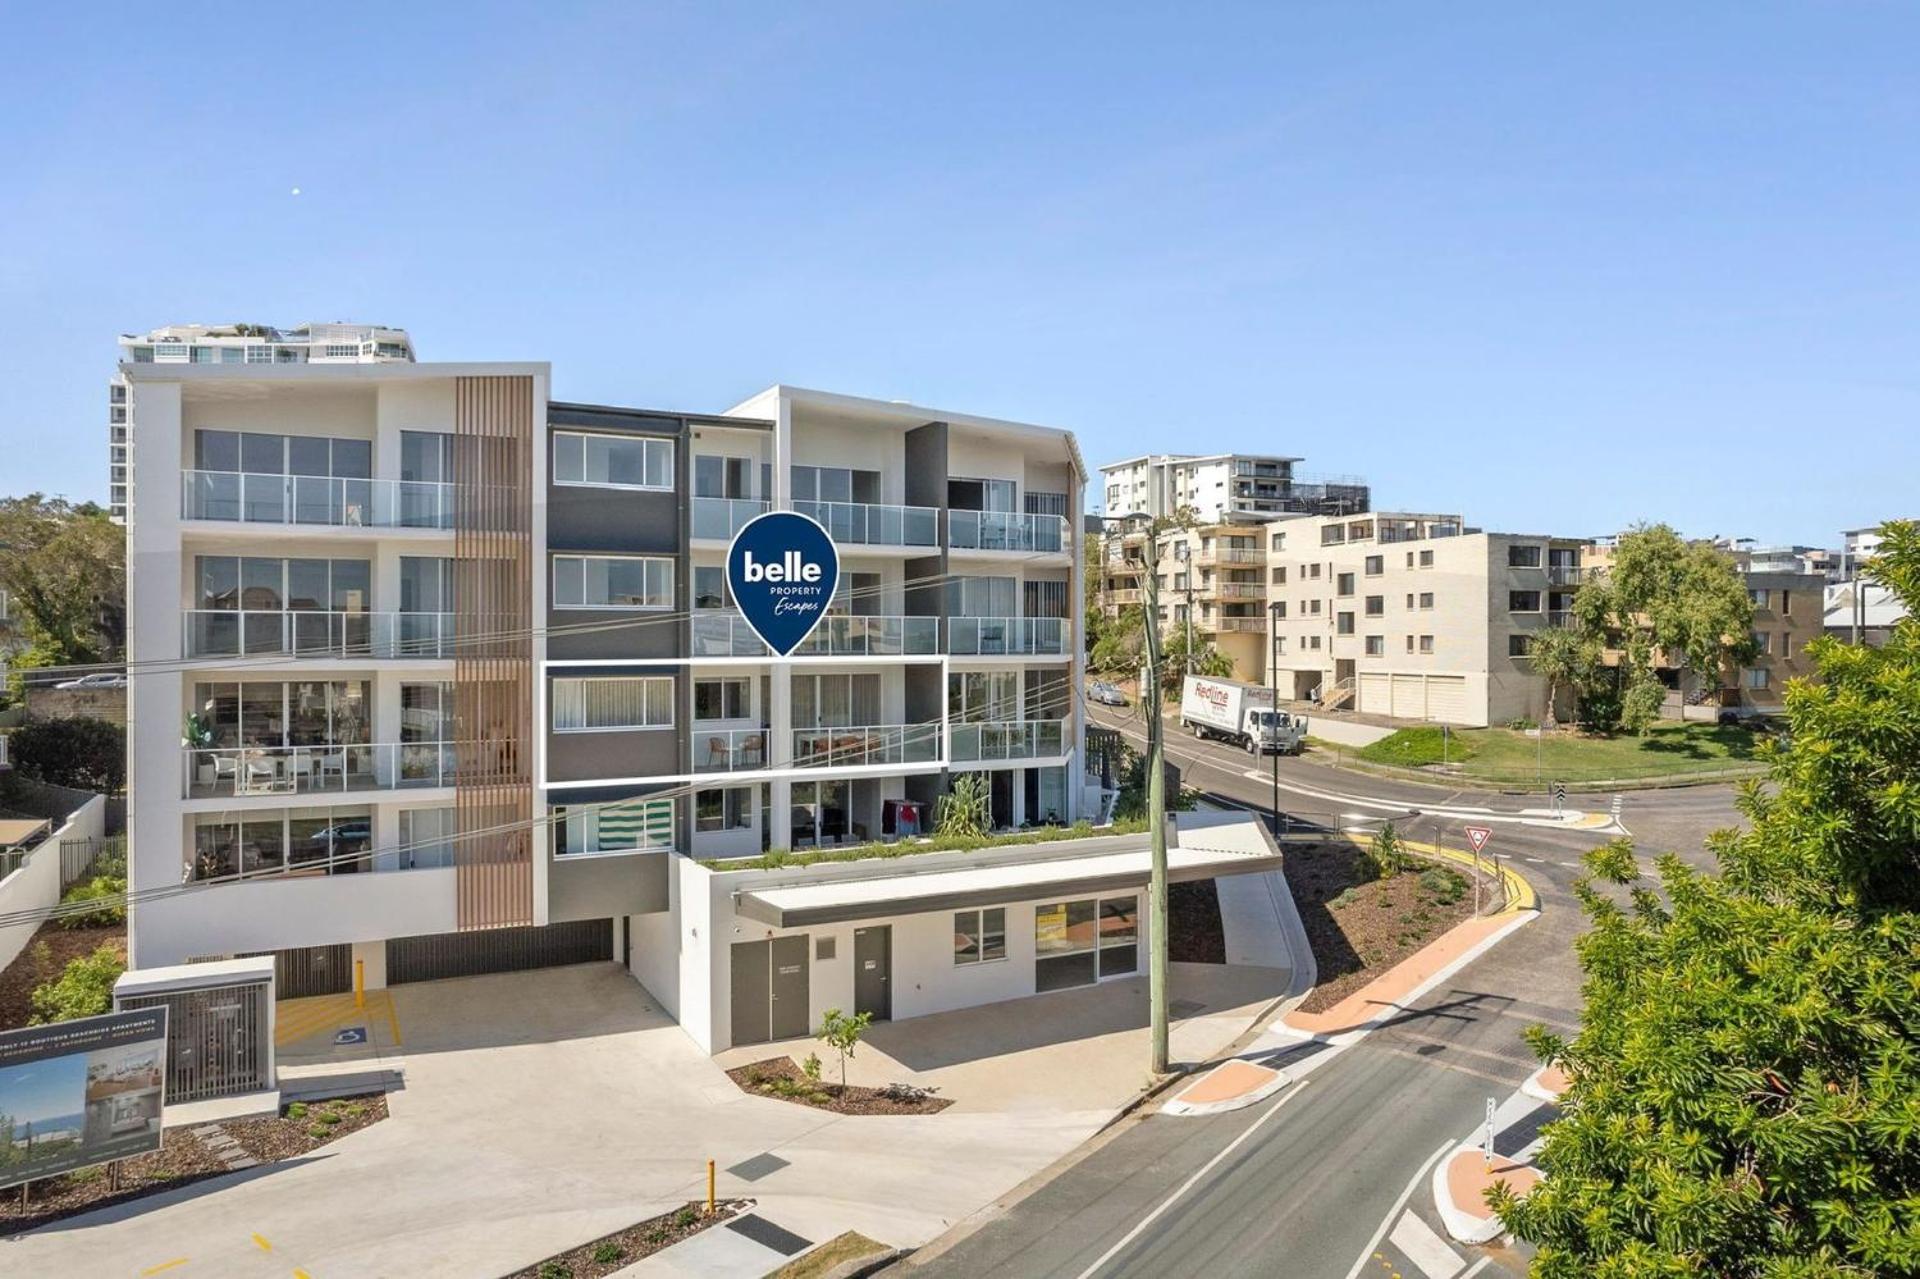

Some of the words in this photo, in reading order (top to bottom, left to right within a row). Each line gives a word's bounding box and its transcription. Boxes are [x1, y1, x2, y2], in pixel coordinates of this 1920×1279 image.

[1195, 682, 1228, 706] Redline
[30, 1035, 68, 1045] BOUTIQUE
[112, 1019, 155, 1030] APARTMENTS
